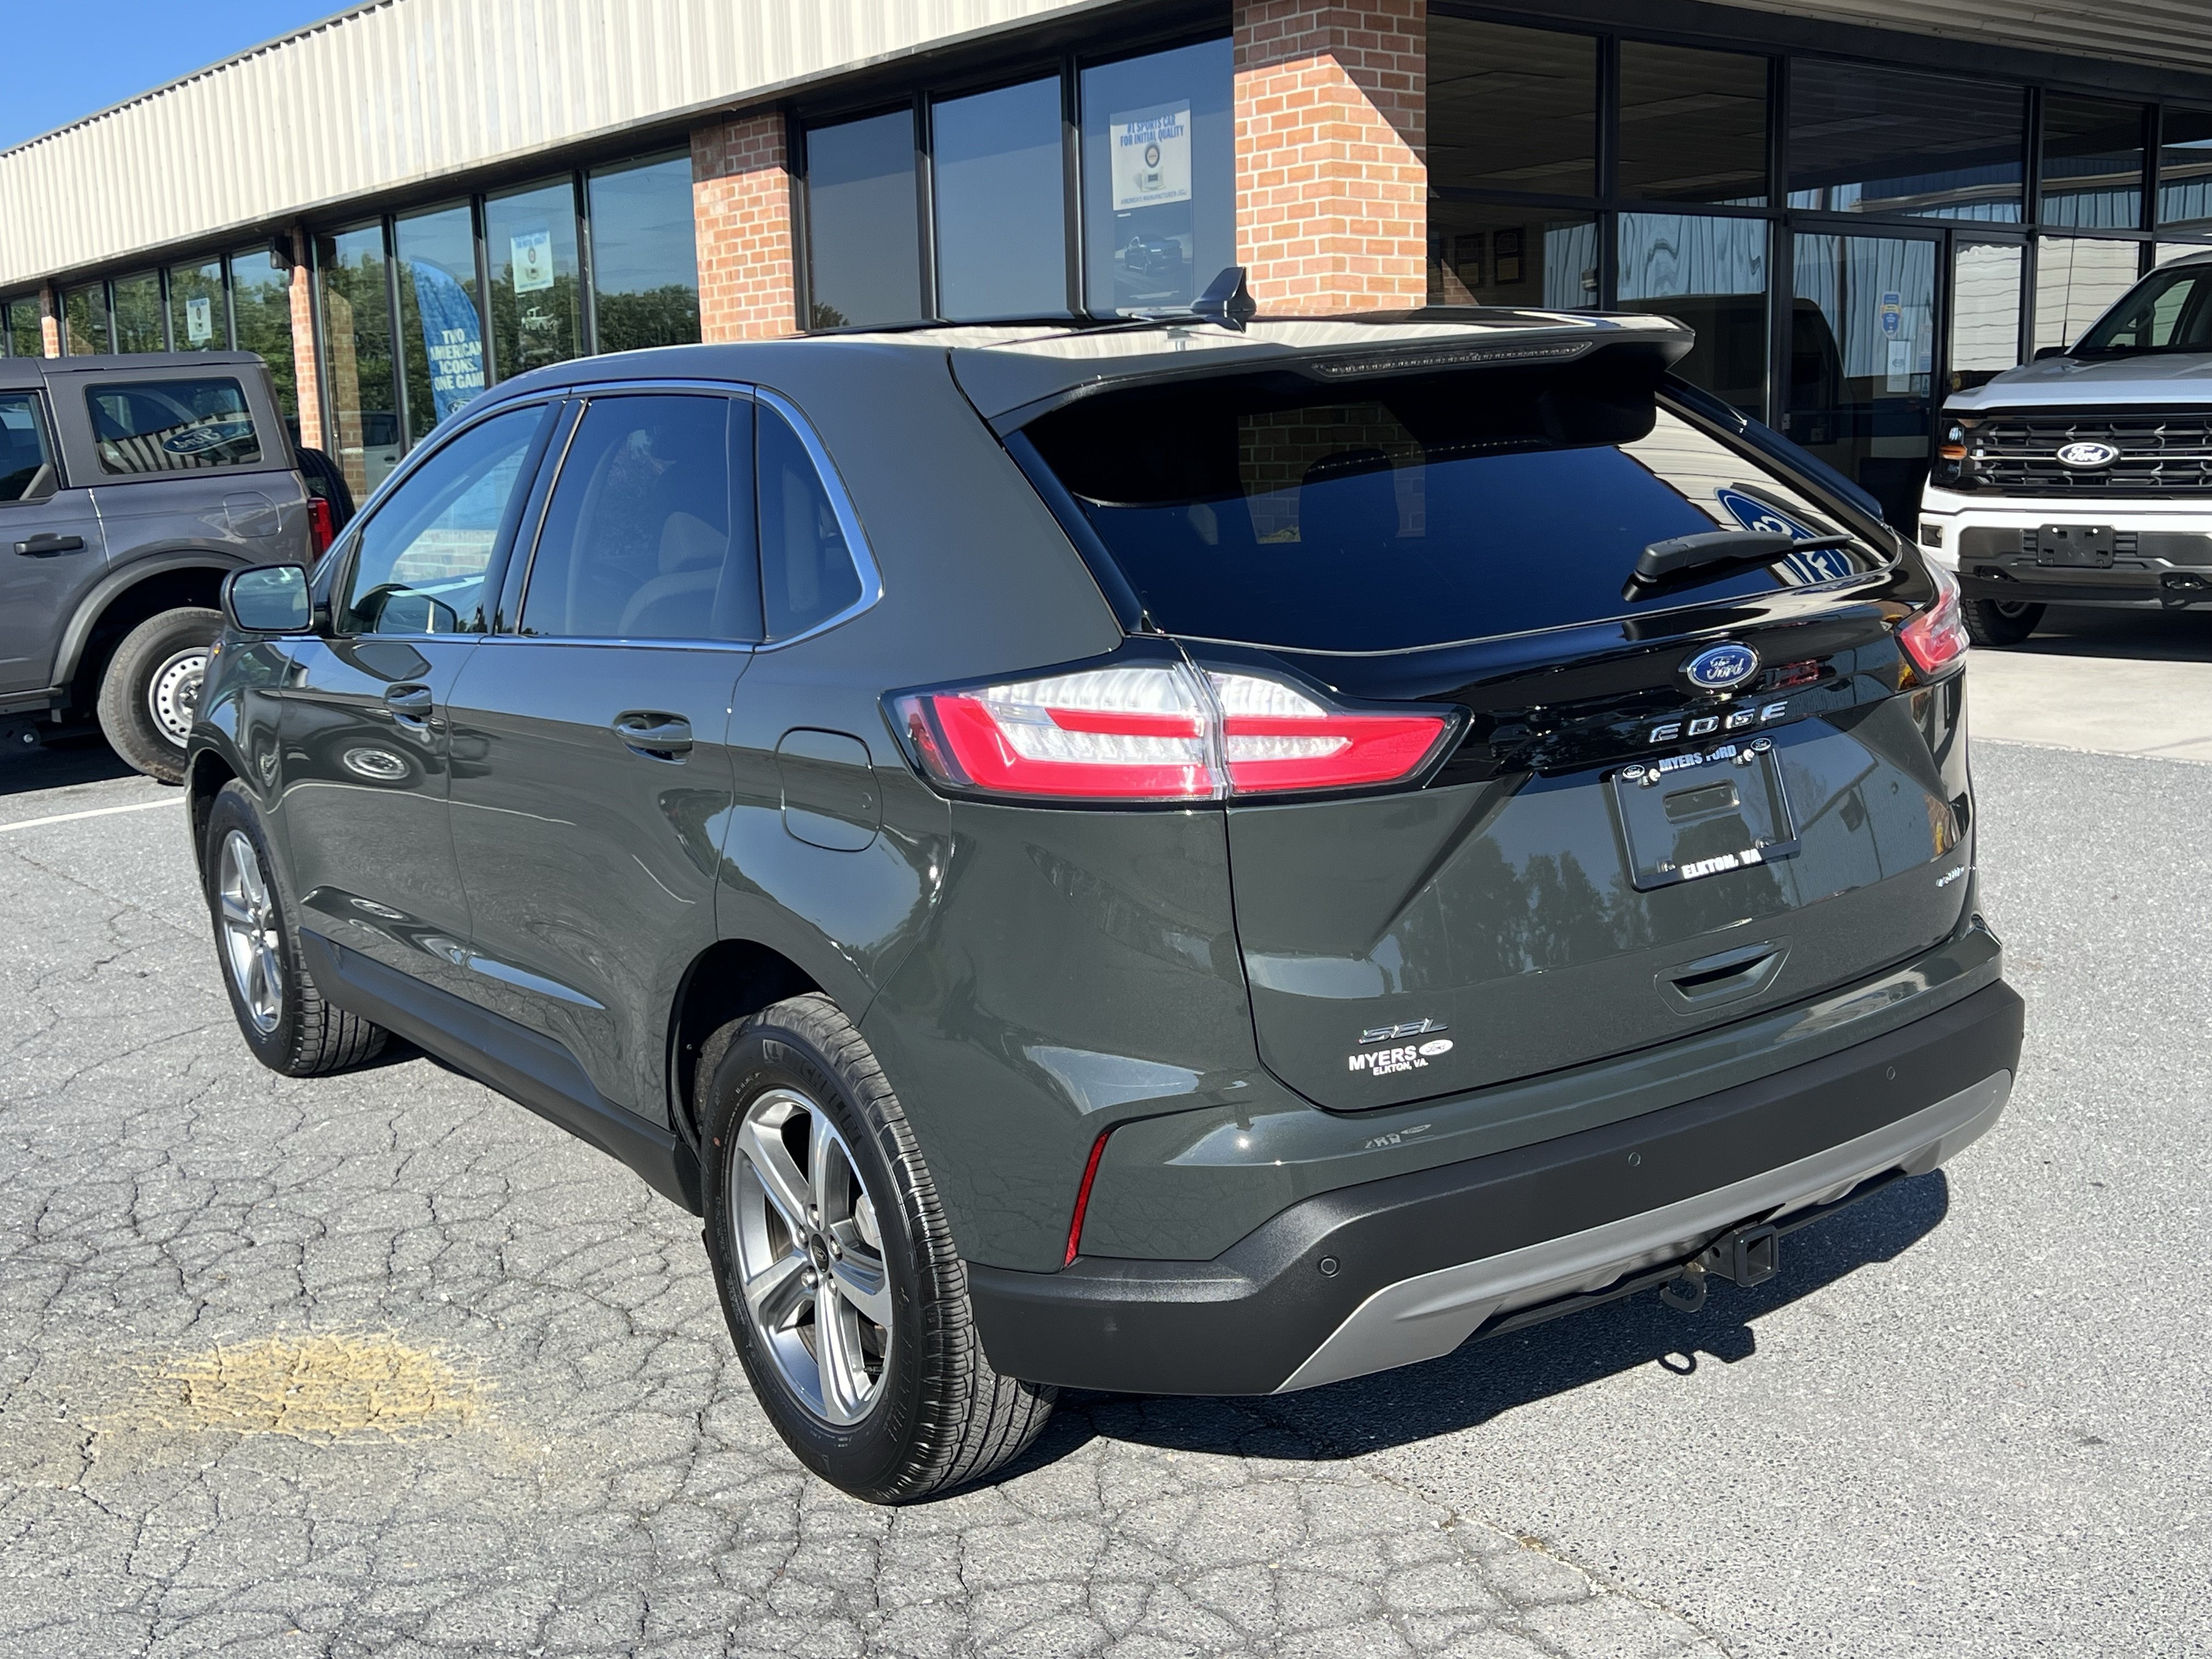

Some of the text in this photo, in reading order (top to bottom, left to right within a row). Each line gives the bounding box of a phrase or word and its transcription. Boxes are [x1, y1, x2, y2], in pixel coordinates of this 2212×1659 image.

[1136, 117, 1161, 133] SPORTS
[1163, 114, 1176, 127] CAR
[1120, 125, 1184, 147] FOR INITIAL QUALITY
[441, 328, 465, 345] TWO
[430, 341, 483, 361] AMERICAN
[439, 358, 478, 375] ICONS.
[434, 375, 455, 391] ONE
[2067, 445, 2103, 461] Ford
[1706, 654, 1745, 680] Ford
[1649, 701, 1788, 743] EDGE
[1658, 752, 1703, 772] MYERS
[1739, 848, 1763, 865] VA
[1358, 1018, 1449, 1045] SEL
[1348, 1045, 1417, 1071] MYERS
[1373, 1058, 1429, 1076] ELKTON, VA.
